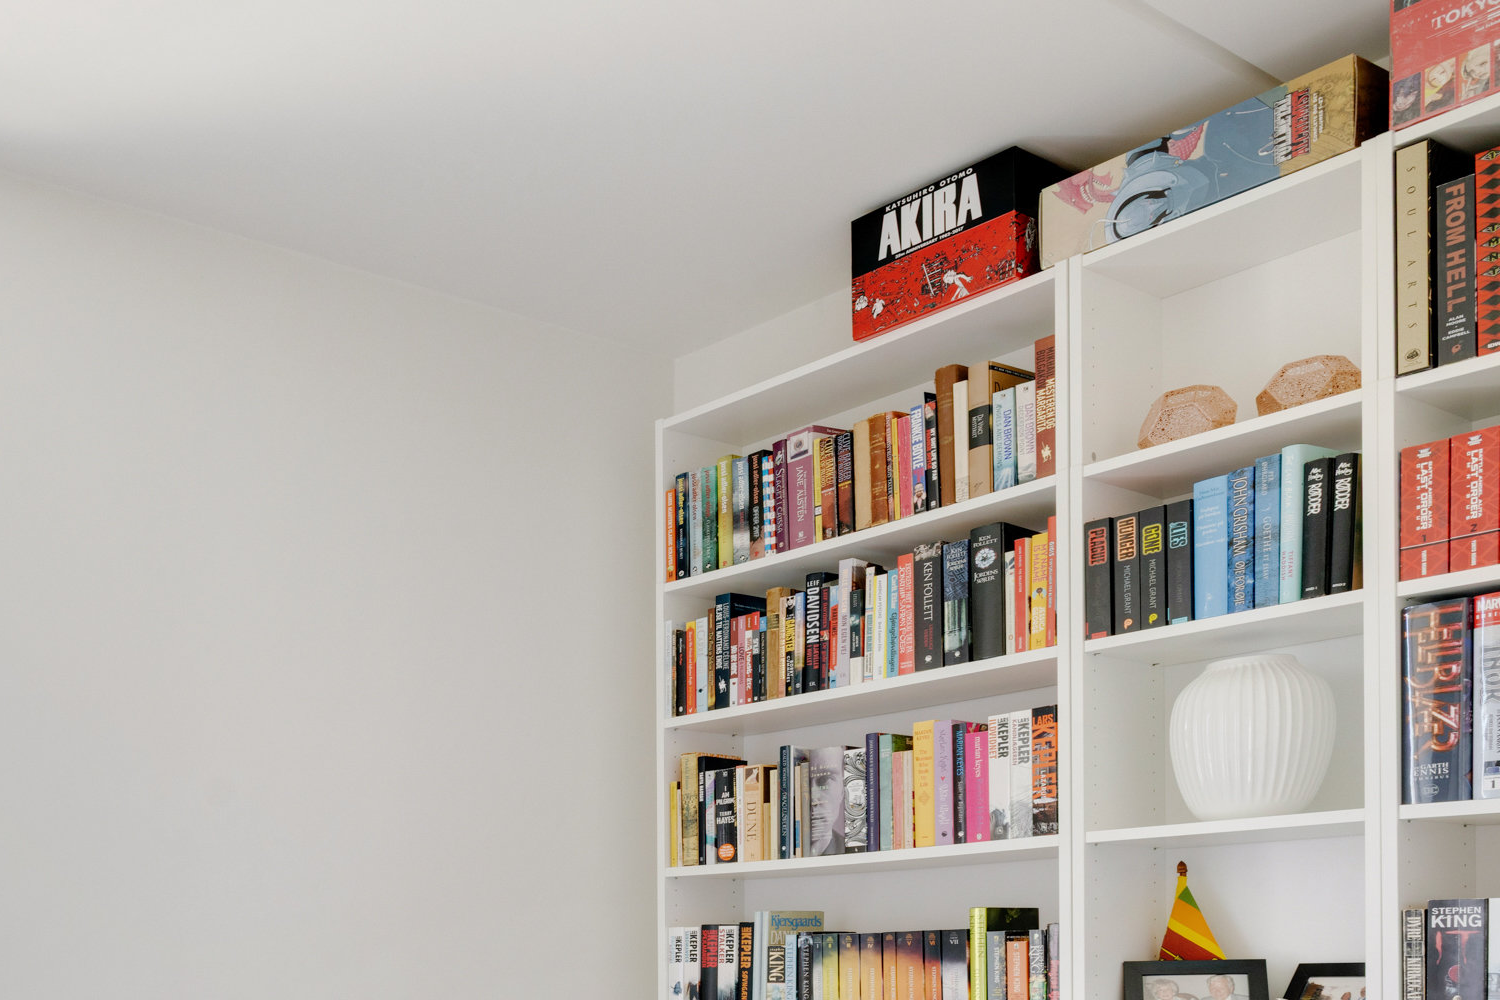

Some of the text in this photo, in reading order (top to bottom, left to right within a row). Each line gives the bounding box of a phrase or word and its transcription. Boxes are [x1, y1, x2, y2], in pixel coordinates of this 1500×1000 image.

[1431, 0, 1500, 30] TOKY
[885, 168, 973, 212] KATSUHIRO OTOMO
[878, 173, 982, 261] AKIRA
[1407, 166, 1417, 329] SOUL ARTS
[1446, 183, 1466, 312] FROM HELL
[1442, 331, 1470, 341] CAMPBELL
[1446, 318, 1466, 326] MOORE
[1036, 389, 1046, 432] MARGARITA
[1046, 378, 1054, 429] MESTEREN OG
[911, 408, 924, 469] FRANKIE BOYLE
[1003, 409, 1012, 460] DAN BROWN
[1025, 403, 1034, 454] DAN BROWN
[842, 433, 851, 480] CLIVE BARKER
[1307, 483, 1321, 516] RØDDER
[1334, 477, 1351, 511] RØDDER
[1420, 462, 1428, 530] LAST ORDER
[1470, 450, 1478, 519] LAST ORDER
[973, 538, 998, 548] FOLLETT
[1118, 518, 1135, 561] HUNGER
[1143, 524, 1161, 555] GONE
[1170, 523, 1187, 548] LIES
[1230, 477, 1247, 606] JOHN GRISHAM ØJE FOR ØJE
[1422, 534, 1426, 542] 1
[1470, 524, 1477, 532] 2
[1041, 544, 1047, 556] MY
[1089, 528, 1106, 565] PLAGUE
[923, 561, 933, 621] KEN FOLLETT
[806, 588, 820, 644] DAVIDSEN
[786, 619, 795, 652] GANGSTER
[989, 719, 997, 759] ILDVIDNET
[997, 723, 1009, 759] KEPLER
[1018, 723, 1030, 764] KEPLER
[973, 759, 982, 777] keyes
[1032, 722, 1057, 800] KEPLER
[716, 815, 735, 825] HAYES
[746, 801, 756, 842] DUNE
[1407, 917, 1421, 940] DYRE
[1431, 914, 1482, 928] KING
[1432, 906, 1482, 915] STEPHEN
[706, 935, 717, 968] KEPLER
[726, 934, 734, 964] KEPLER
[741, 932, 751, 968] KEPLER
[1029, 945, 1040, 974] KING
[1436, 930, 1482, 965] IT
[769, 951, 784, 982] KING
